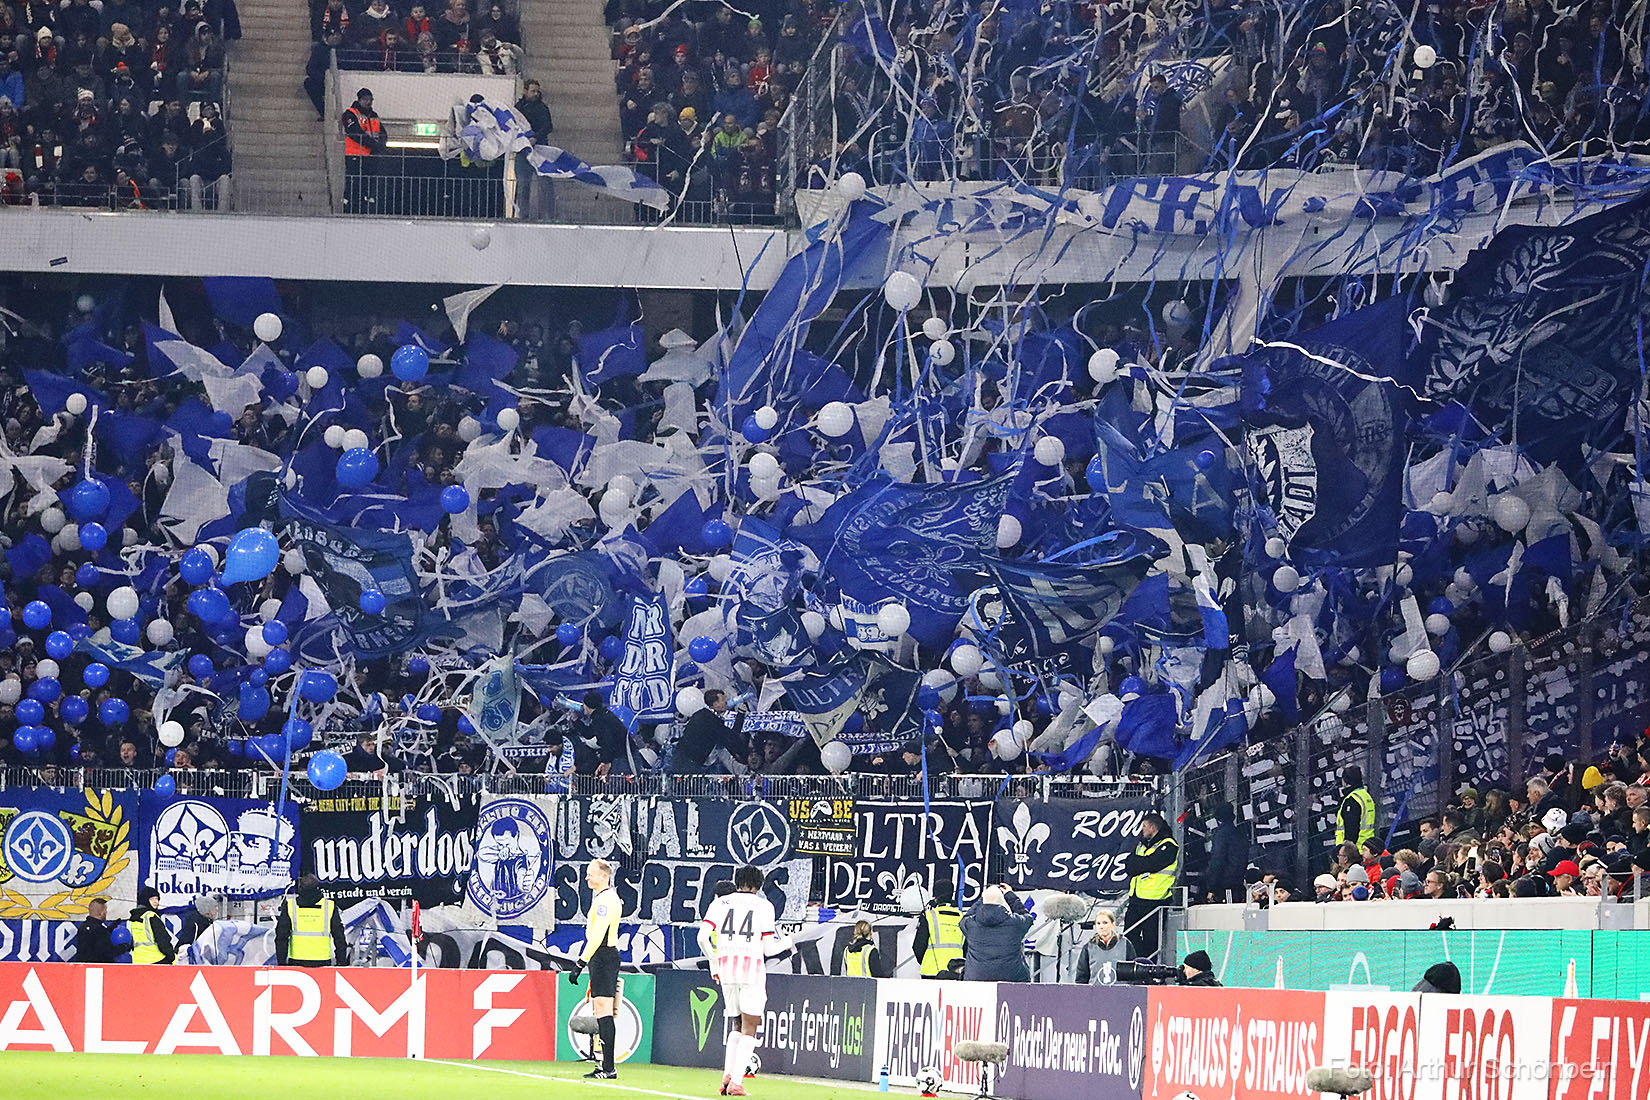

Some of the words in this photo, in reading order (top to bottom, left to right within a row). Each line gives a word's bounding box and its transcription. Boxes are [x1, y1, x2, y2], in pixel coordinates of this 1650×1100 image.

[313, 806, 475, 893] underdog
[833, 861, 875, 900] DE
[1047, 851, 1132, 883] SEVE
[337, 887, 365, 898] stadt
[365, 886, 388, 898] und
[387, 886, 413, 897] verein
[720, 908, 755, 943] 44
[0, 966, 427, 1059] ALARM
[800, 999, 841, 1069] fertig,
[842, 1001, 866, 1056] los!
[1045, 1016, 1064, 1071] Der
[1063, 1026, 1087, 1074] neue
[1088, 1019, 1122, 1076] T-Roc.
[1164, 1015, 1229, 1089] STRAUSS
[1244, 1017, 1317, 1096] STRAUSS
[1346, 1004, 1418, 1100] ERGO
[1440, 1007, 1515, 1100] ERGO
